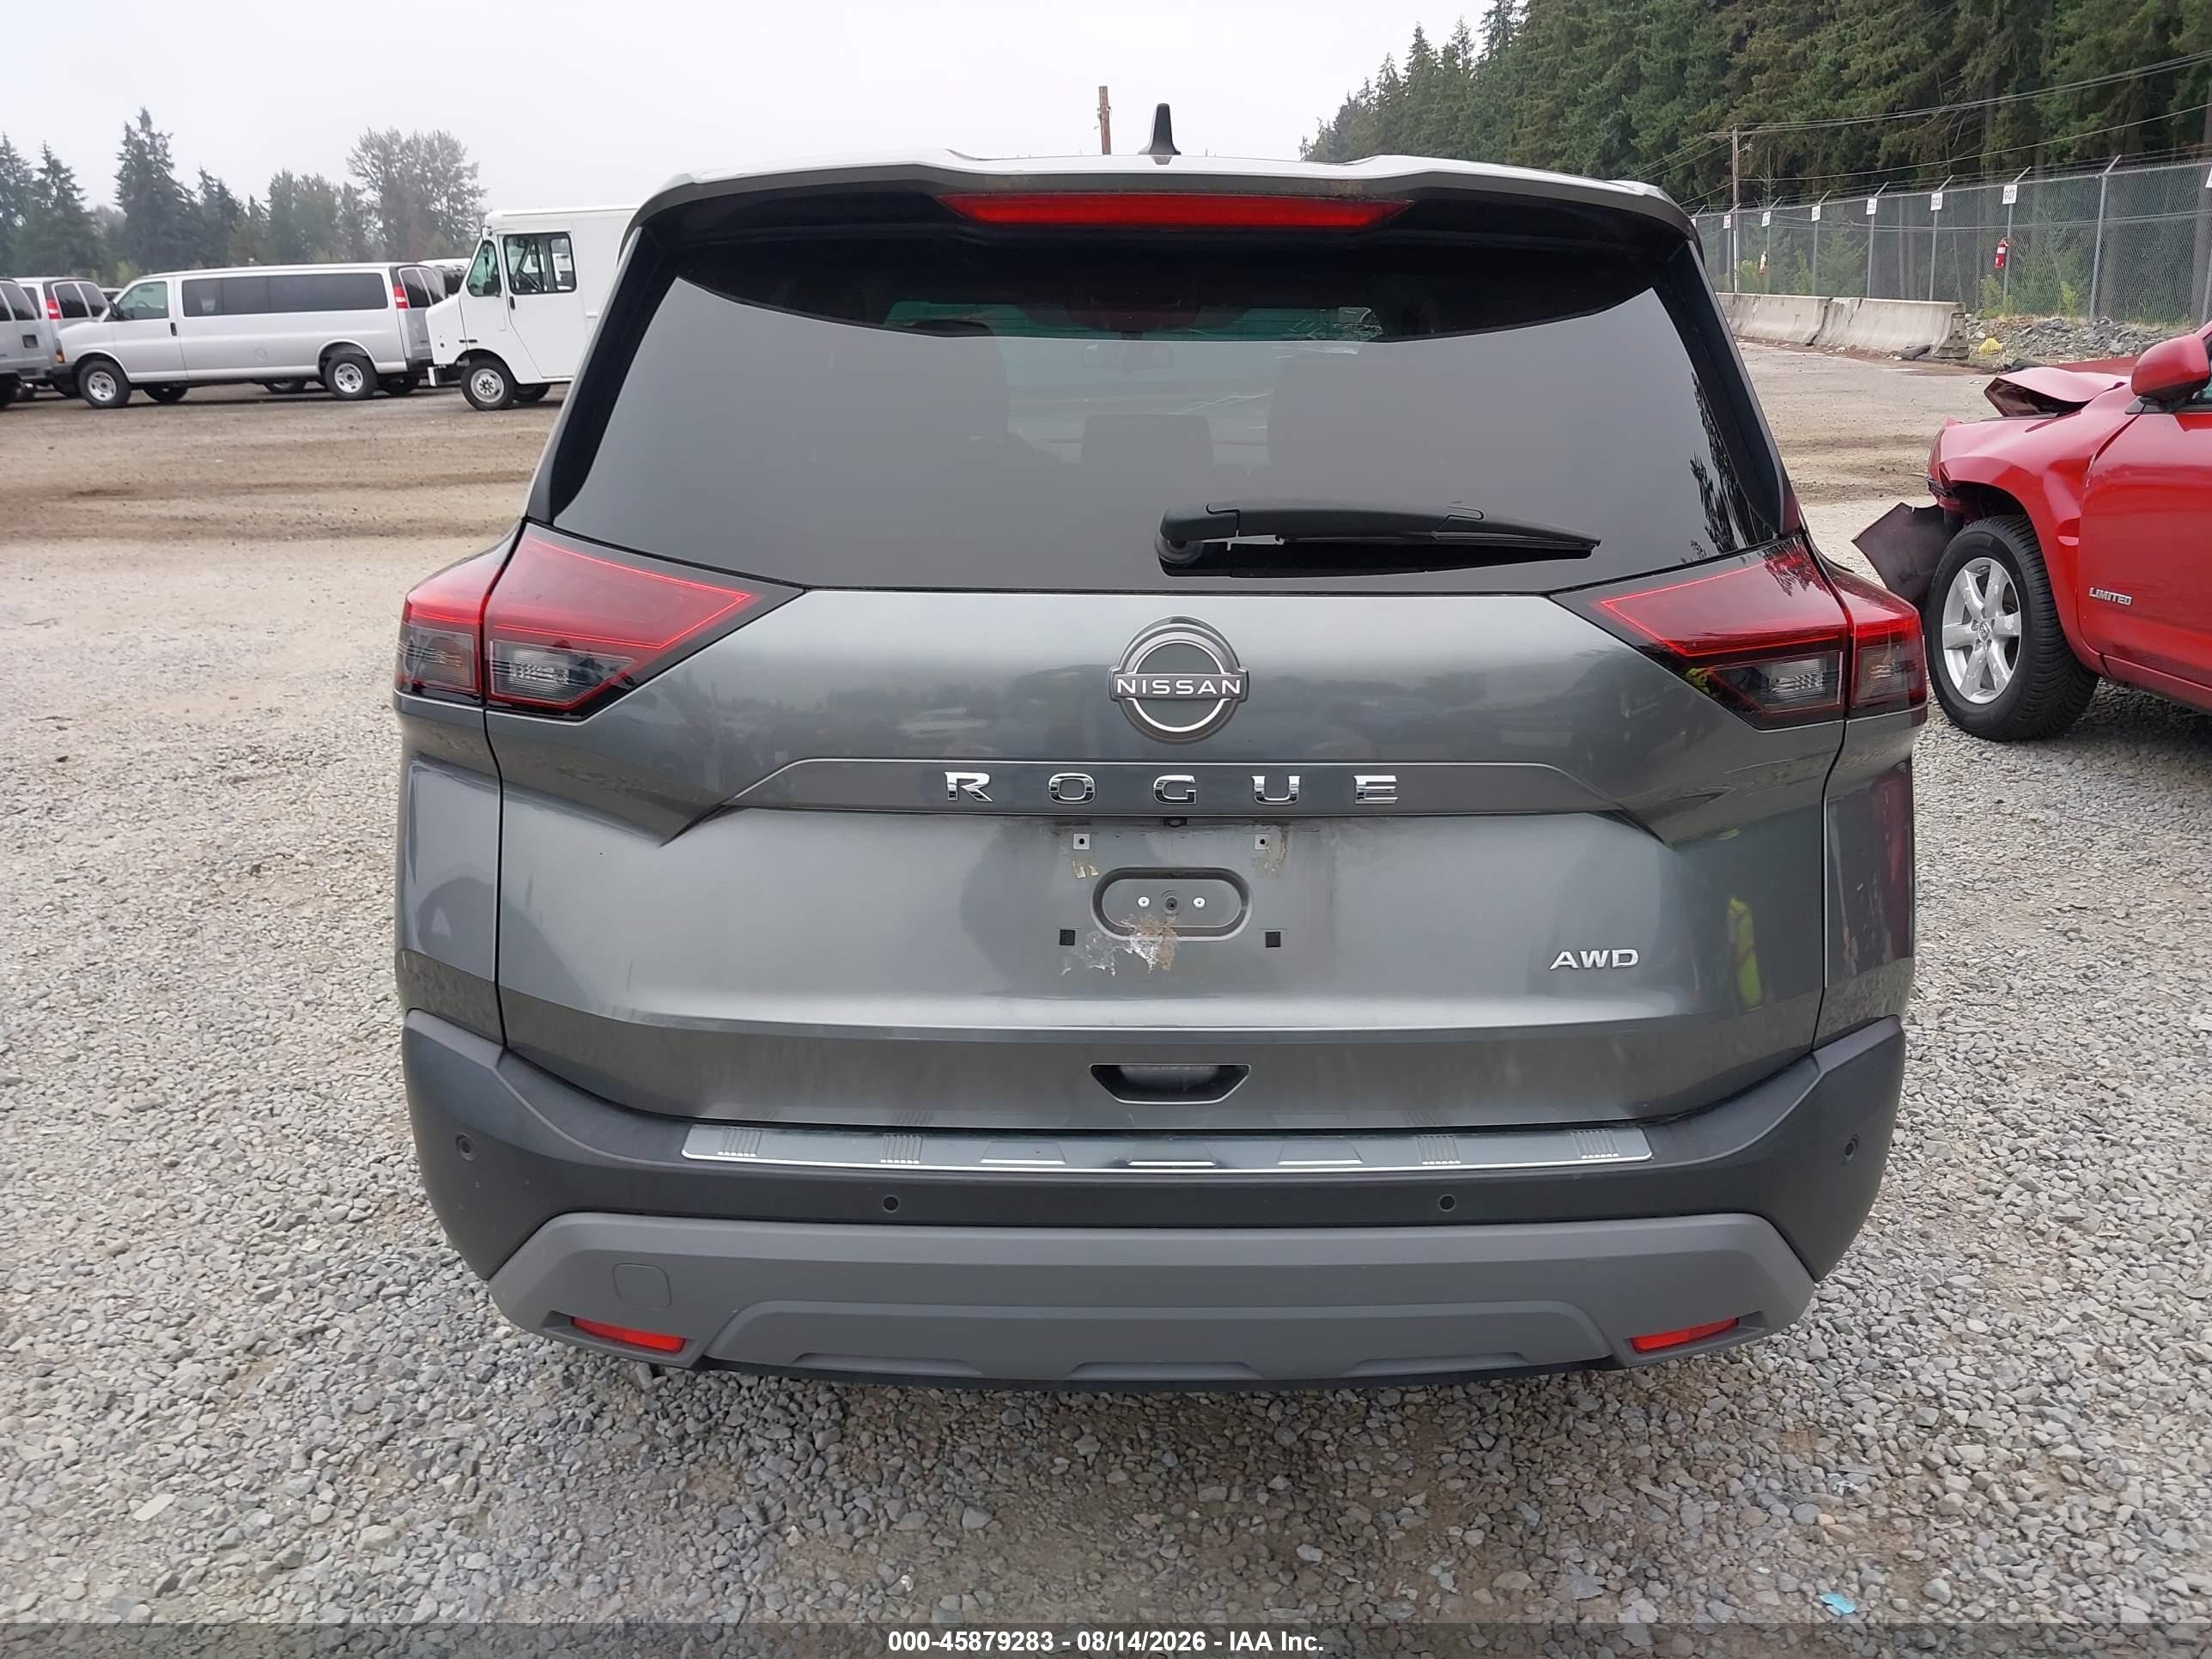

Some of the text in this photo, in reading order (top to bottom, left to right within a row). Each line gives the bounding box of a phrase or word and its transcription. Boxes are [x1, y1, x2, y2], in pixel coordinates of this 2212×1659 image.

[2088, 587, 2132, 606] LIMITED
[1116, 677, 1242, 696] NISSAN
[944, 771, 1399, 805] ROGUE
[1548, 949, 1640, 969] AWD
